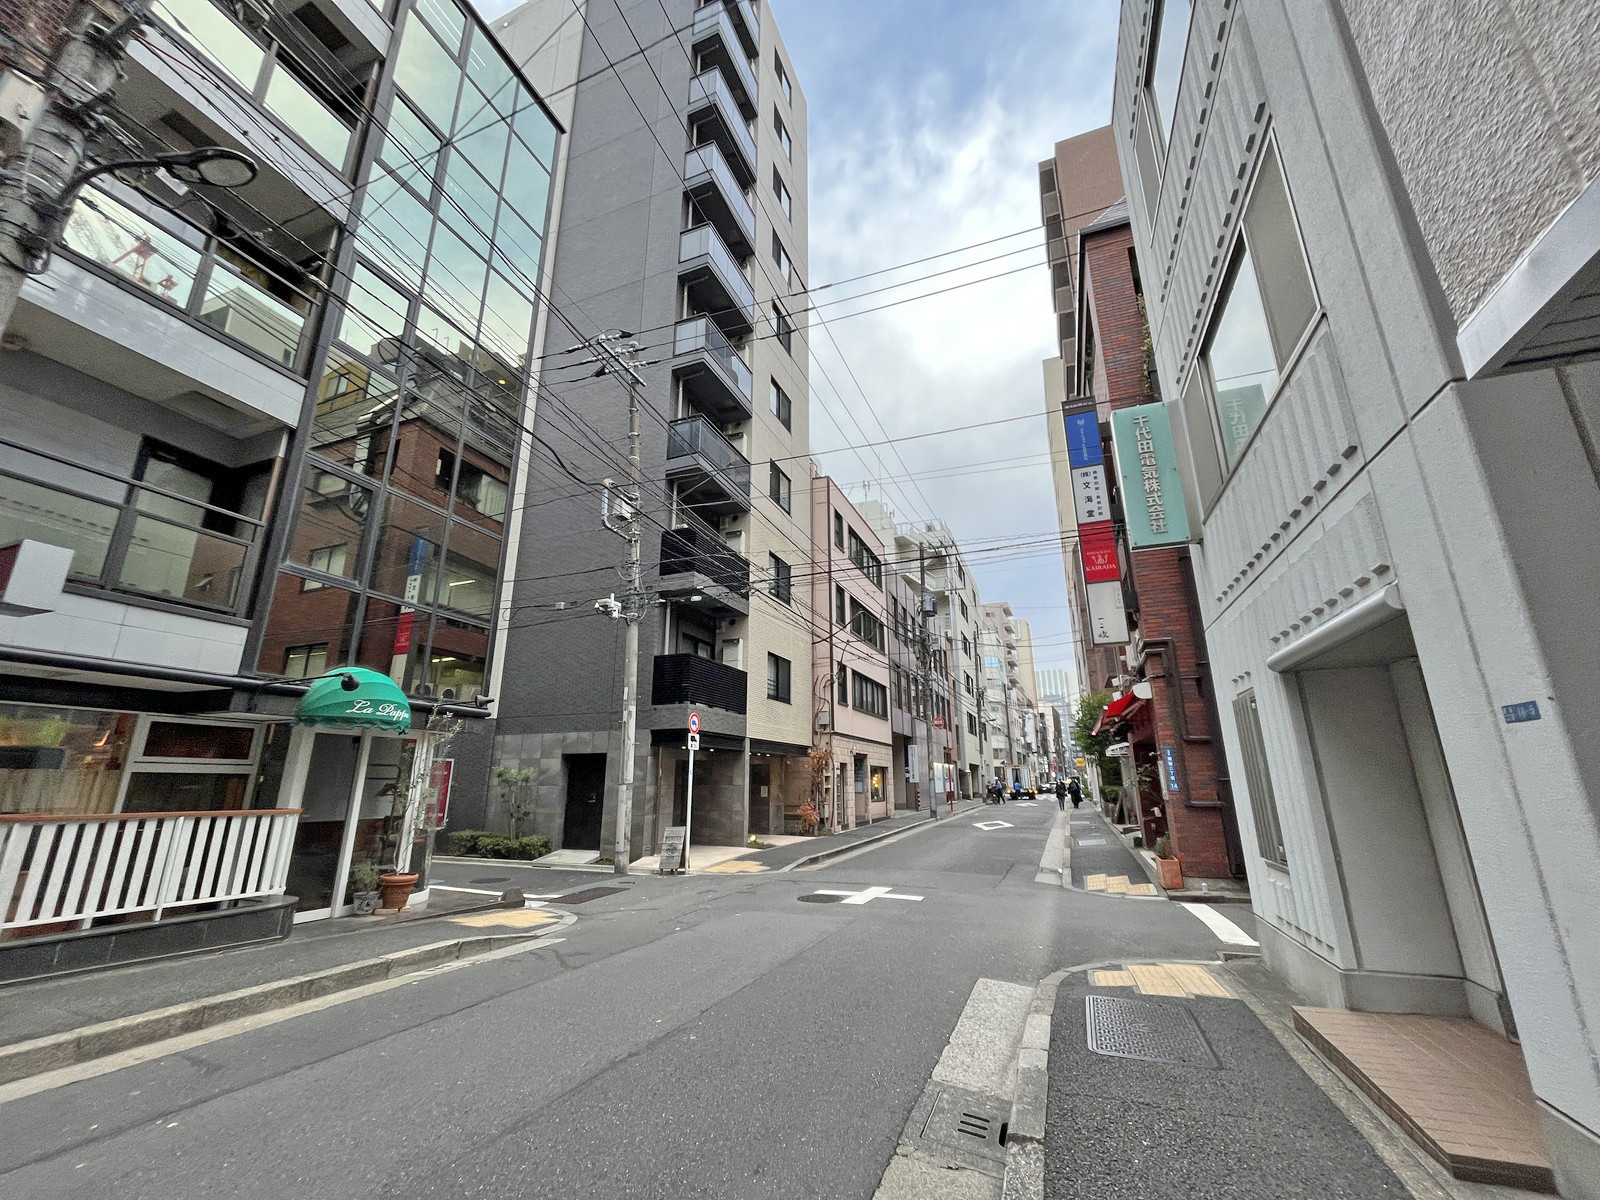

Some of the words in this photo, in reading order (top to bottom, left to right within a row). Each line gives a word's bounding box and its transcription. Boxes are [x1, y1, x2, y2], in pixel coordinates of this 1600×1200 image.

[1133, 414, 1168, 534] 千代田電気株式会社
[1085, 563, 1117, 572] KAIRADA
[346, 699, 374, 714] La
